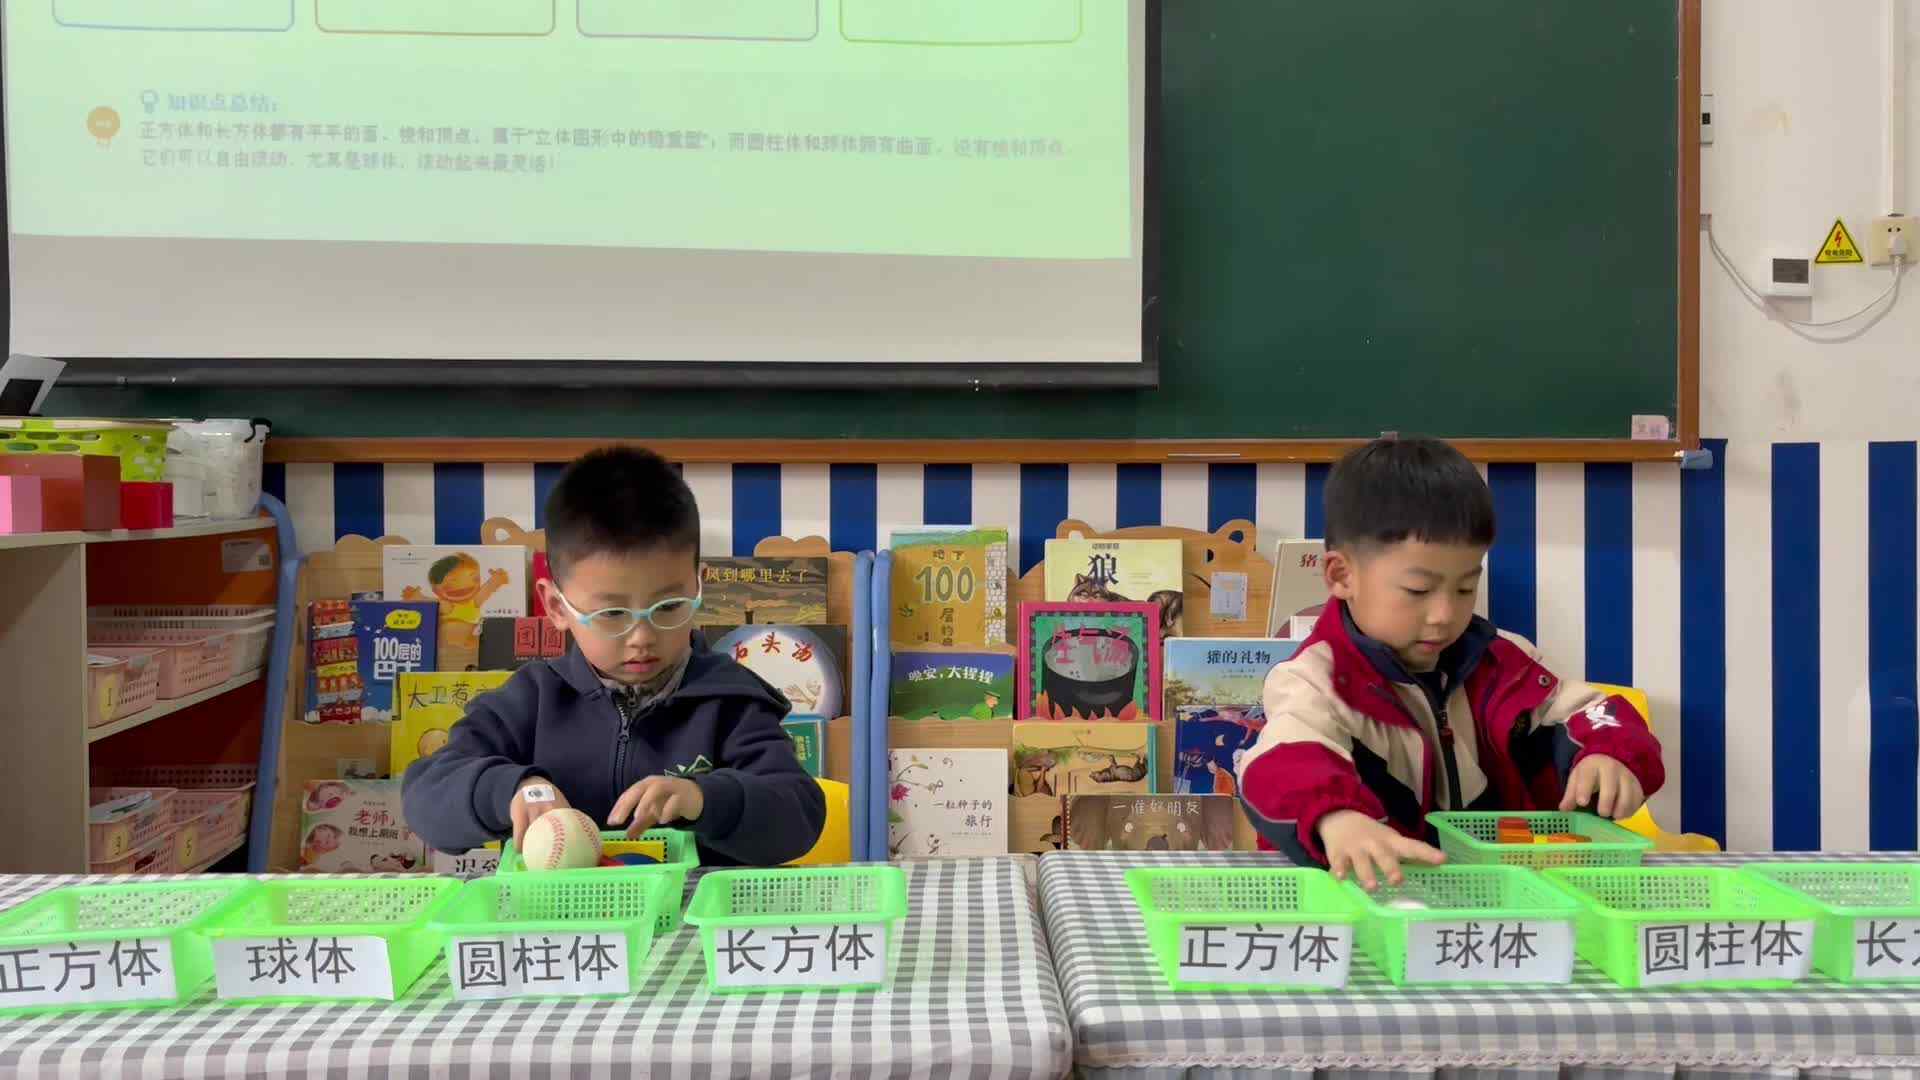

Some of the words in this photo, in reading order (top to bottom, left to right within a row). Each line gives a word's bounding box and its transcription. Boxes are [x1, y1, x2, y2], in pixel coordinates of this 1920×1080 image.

[932, 548, 966, 560] 地下
[1088, 553, 1119, 587] 狼
[704, 567, 809, 584] 风到哪里去了
[914, 565, 976, 604] 100
[372, 636, 423, 661] 100层的
[732, 631, 814, 662] 石头汤
[1207, 649, 1271, 665] 獾的礼物
[931, 799, 993, 811] 一粒种子的
[964, 815, 993, 829] 旅行
[245, 936, 357, 985] 球体
[457, 934, 619, 990] 圆柱体
[716, 924, 876, 975] 长方体
[1179, 922, 1340, 973] 正方体
[1434, 921, 1538, 970] 球体
[1644, 919, 1804, 975] 圆柱体
[1856, 920, 1920, 968] 长
[0, 937, 162, 994] 正方体
